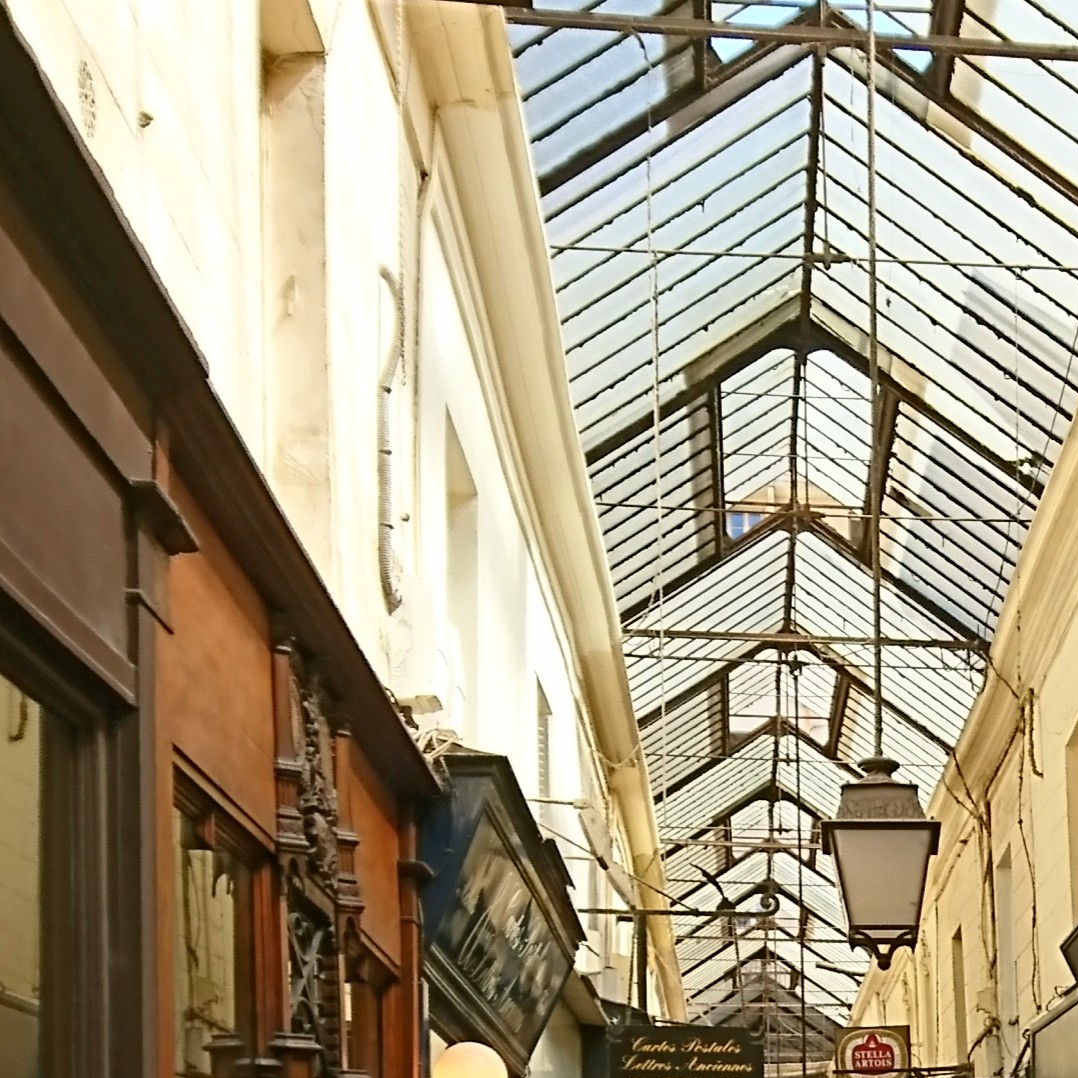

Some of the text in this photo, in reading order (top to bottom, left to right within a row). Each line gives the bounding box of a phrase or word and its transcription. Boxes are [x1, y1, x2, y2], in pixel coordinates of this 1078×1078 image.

[631, 1036, 742, 1054] Cartes Postales
[854, 1049, 892, 1059] STELLA
[621, 1054, 753, 1073] Lettres Anciennes
[854, 1059, 893, 1069] ARTOIS
